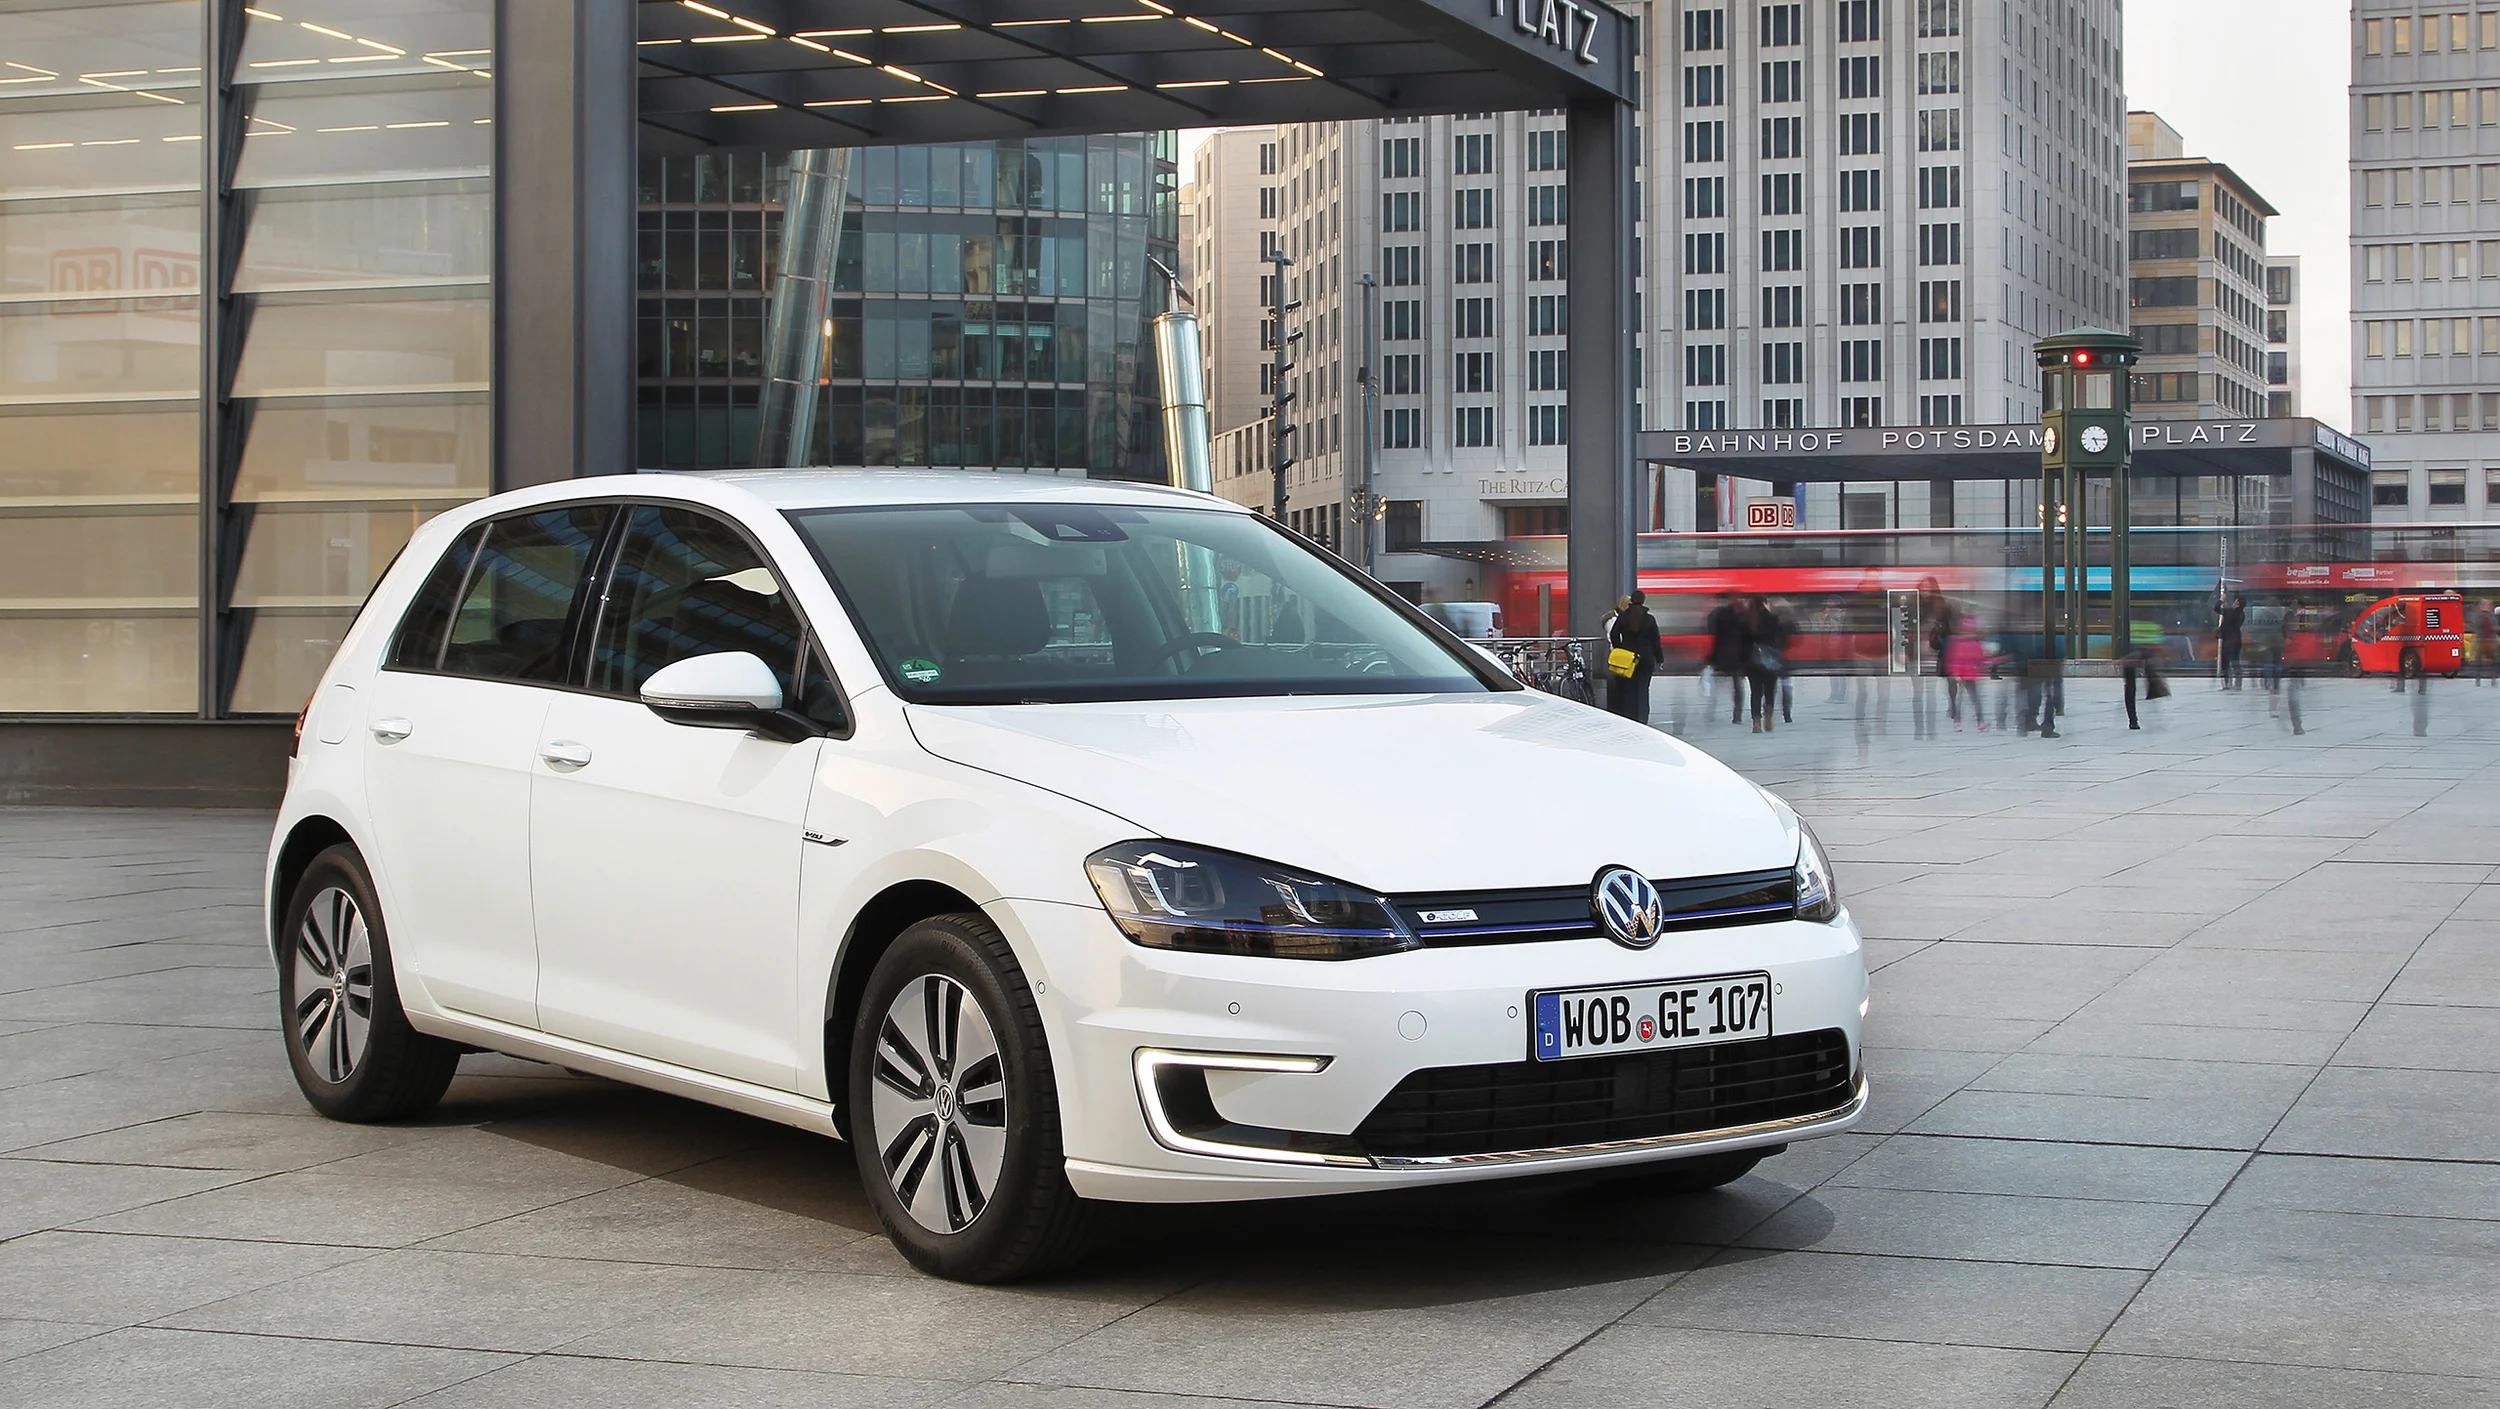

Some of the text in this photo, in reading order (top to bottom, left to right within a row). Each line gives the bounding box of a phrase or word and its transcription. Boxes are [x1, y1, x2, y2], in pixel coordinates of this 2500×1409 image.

[1674, 433, 1843, 453] BAHNHOF
[2142, 424, 2257, 444] PLATZ
[1752, 507, 1776, 524] DB
[1563, 982, 1765, 1048] WOB GE 107
[1544, 1032, 1554, 1047] D
